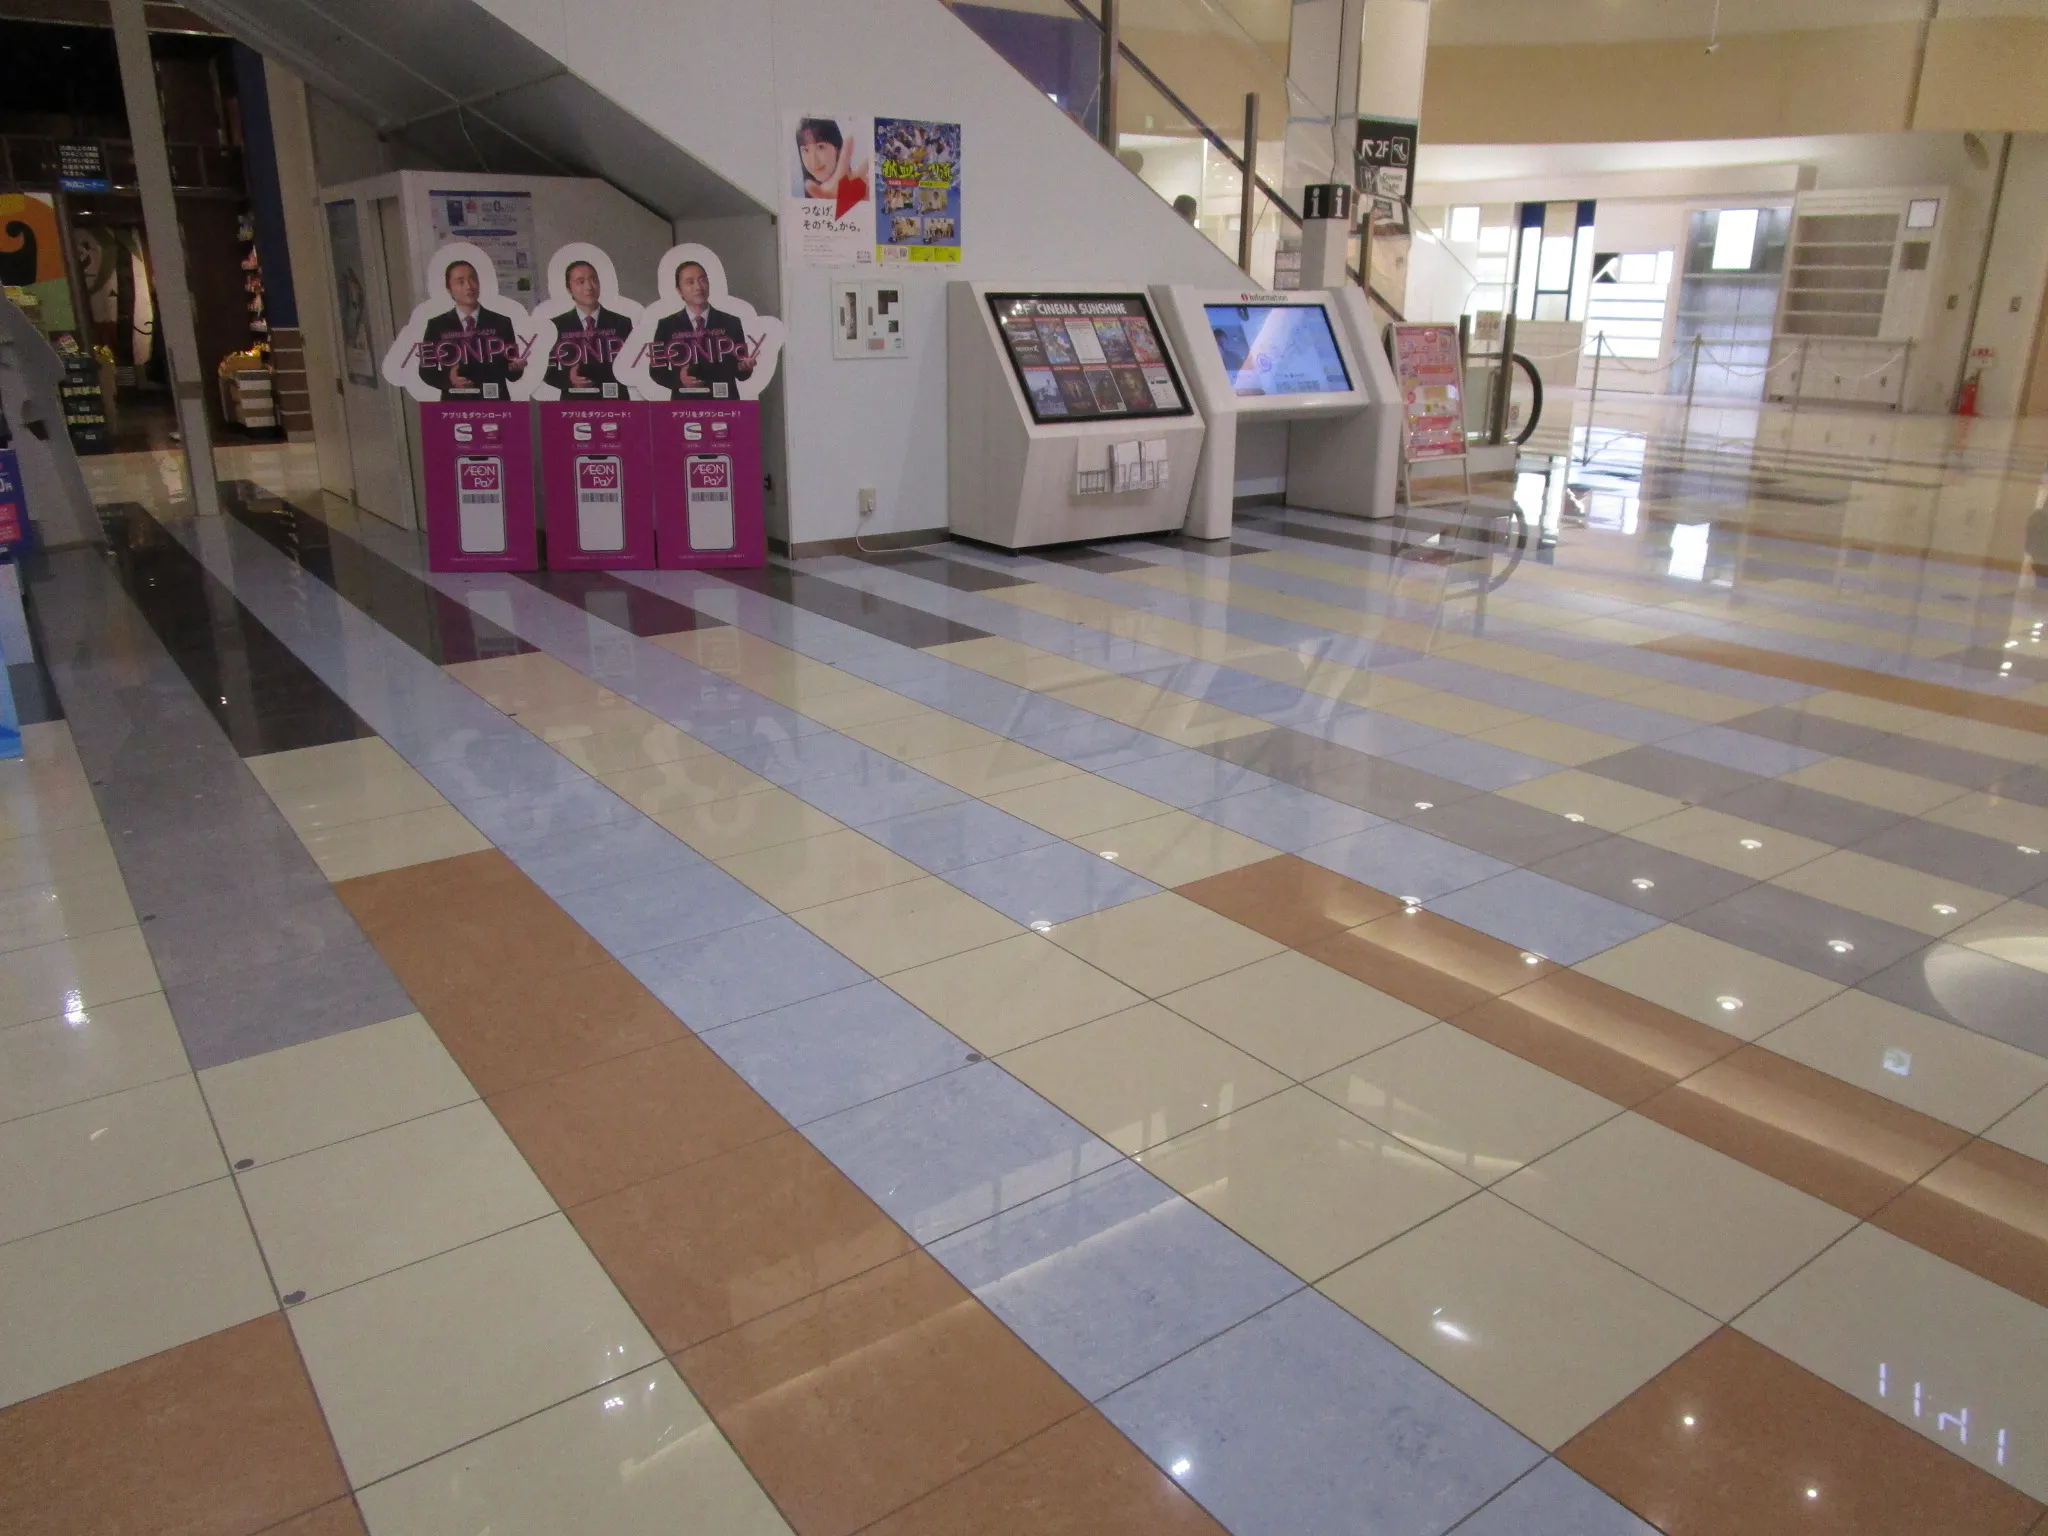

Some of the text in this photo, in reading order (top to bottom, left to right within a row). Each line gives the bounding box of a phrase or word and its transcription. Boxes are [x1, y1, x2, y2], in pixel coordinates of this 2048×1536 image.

[1375, 140, 1390, 158] 2F
[1036, 303, 1077, 315] CINEMA
[1078, 302, 1128, 315] SUNSHINE
